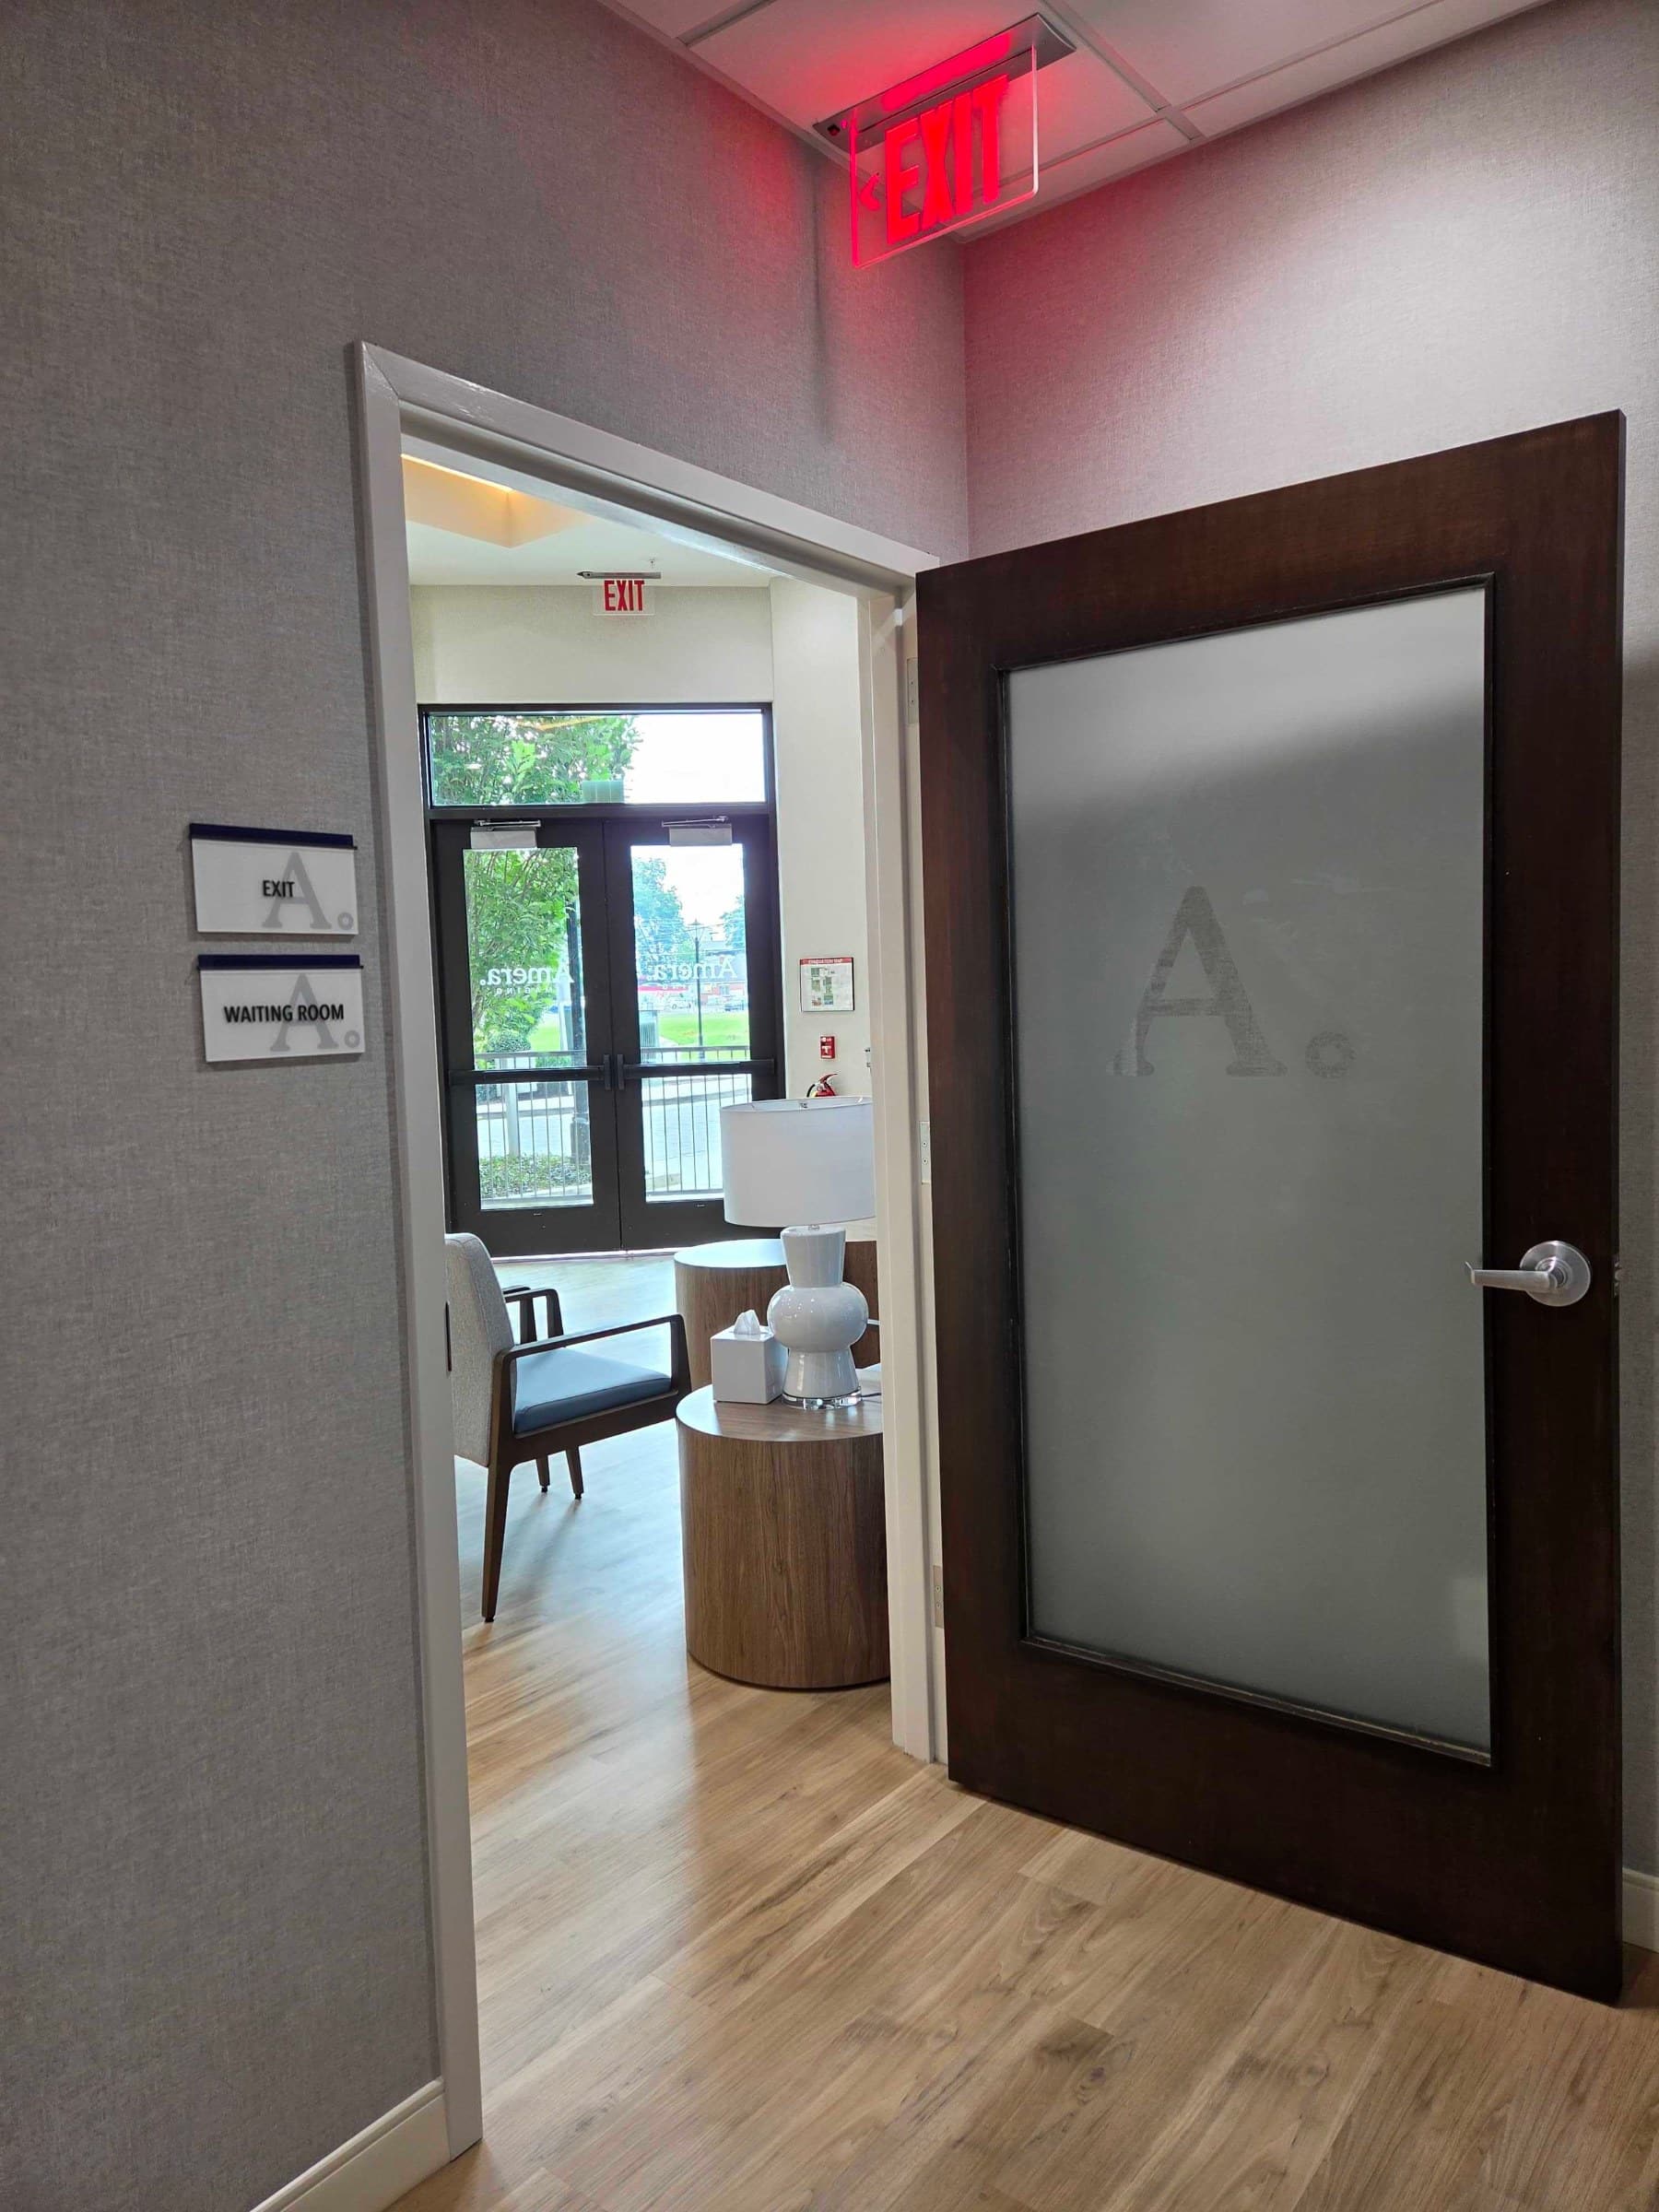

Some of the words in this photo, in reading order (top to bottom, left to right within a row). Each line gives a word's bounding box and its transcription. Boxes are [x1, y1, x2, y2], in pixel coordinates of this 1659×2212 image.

[885, 74, 1010, 245] EXIT
[604, 580, 645, 611] EXIT
[262, 879, 295, 898] EXIT
[223, 1005, 293, 1023] WAITING
[297, 1004, 345, 1022] ROOM
